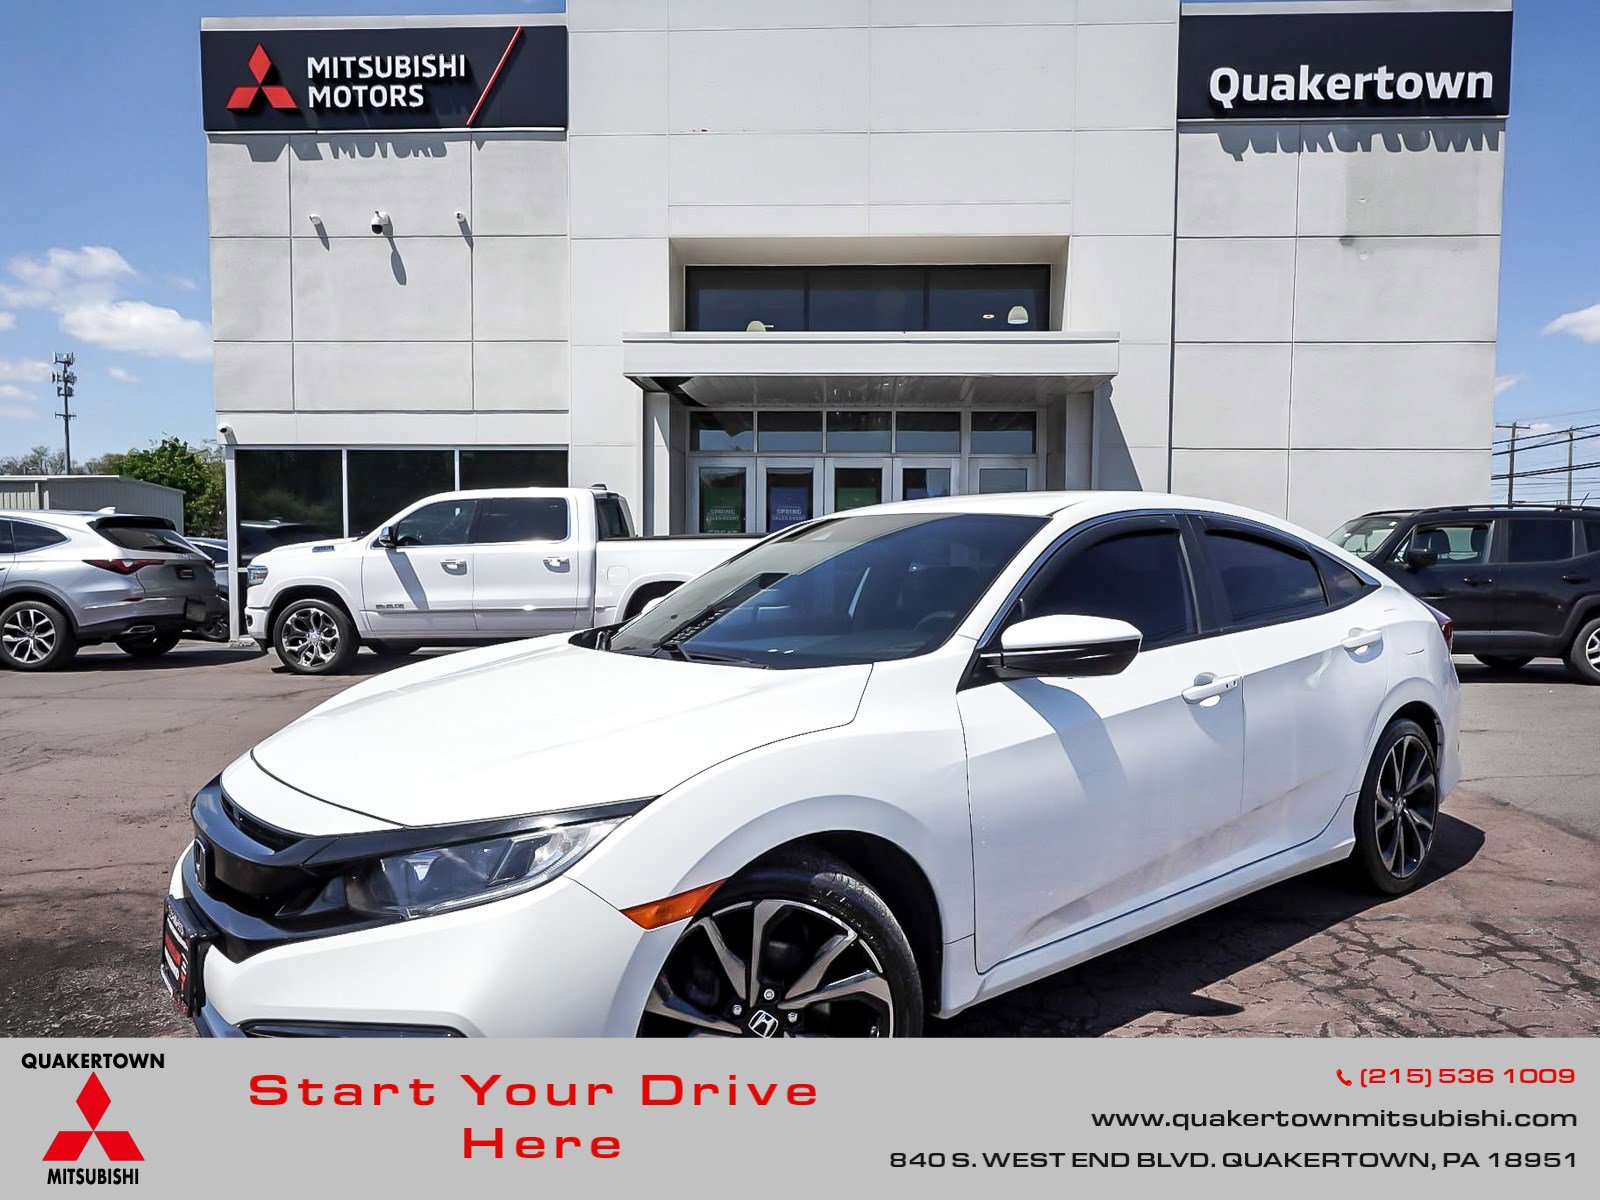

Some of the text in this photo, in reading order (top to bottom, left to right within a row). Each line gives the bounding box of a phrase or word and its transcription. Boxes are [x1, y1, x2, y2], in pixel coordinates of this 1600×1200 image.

[307, 54, 465, 79] MITSUBISHI
[308, 84, 424, 108] MOTORS
[1209, 64, 1493, 109] Quakertown
